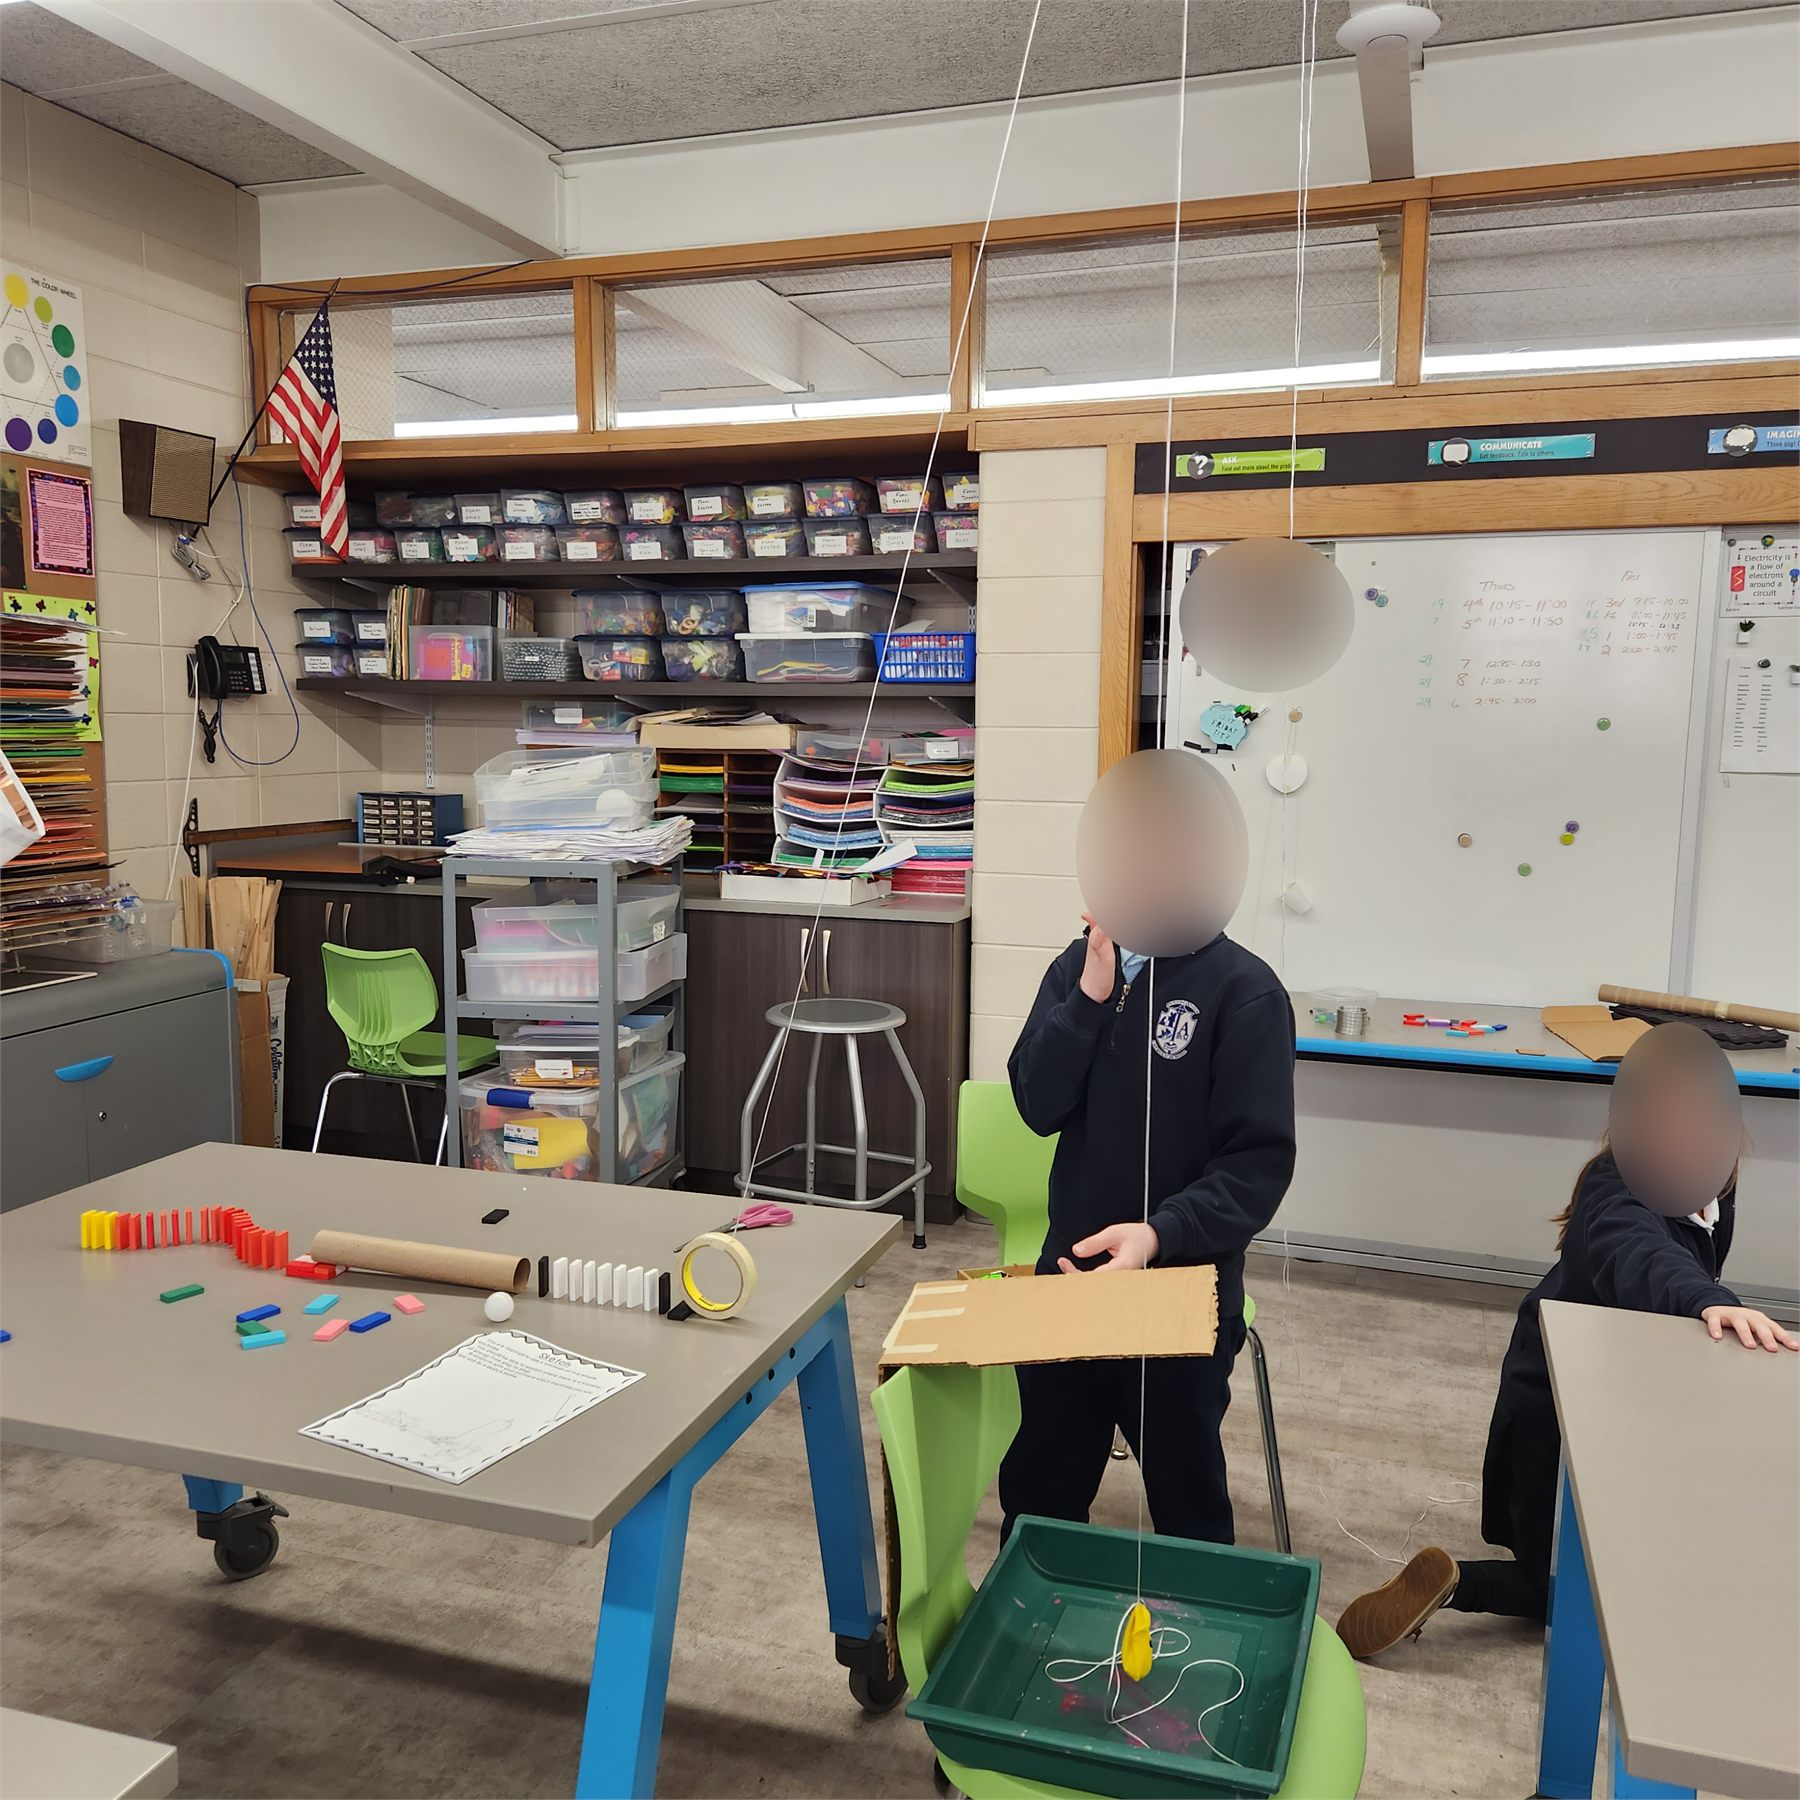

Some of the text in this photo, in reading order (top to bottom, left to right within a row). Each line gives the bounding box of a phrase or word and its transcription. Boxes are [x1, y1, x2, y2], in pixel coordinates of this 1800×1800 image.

[30, 278, 41, 287] THE
[42, 282, 58, 293] COLOR
[1480, 441, 1543, 451] COMMUNICATE
[1222, 456, 1238, 464] ASK
[1744, 554, 1783, 562] Electricity
[1479, 580, 1517, 592] Thurs
[1211, 719, 1238, 734] FRIDAY
[539, 1352, 572, 1368] Sketch
